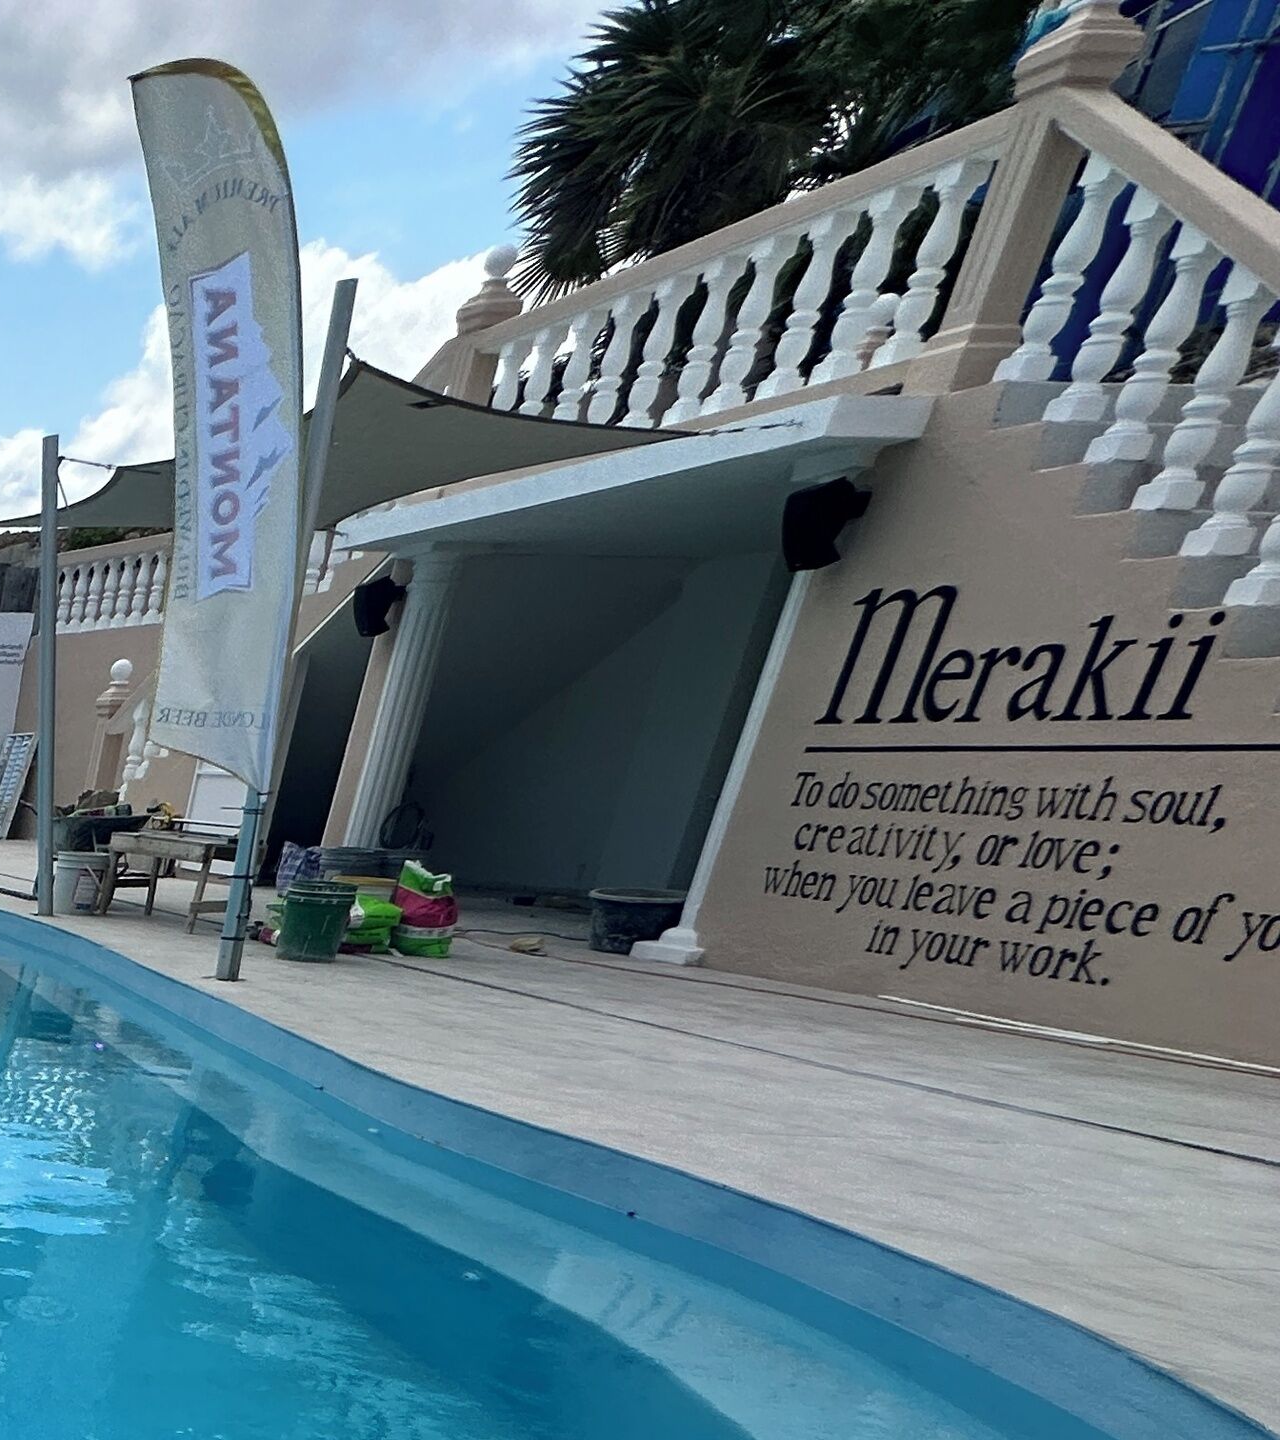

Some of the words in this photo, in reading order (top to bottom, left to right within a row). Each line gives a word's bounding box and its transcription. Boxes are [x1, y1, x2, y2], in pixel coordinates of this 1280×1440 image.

[814, 584, 1226, 726] Merakii
[791, 771, 825, 807] To
[828, 771, 860, 809] do
[860, 776, 1030, 821] something
[1036, 776, 1119, 821] with
[1122, 784, 1227, 833] soul,
[794, 822, 966, 873] creativity,
[976, 833, 1018, 867] or
[1018, 830, 1121, 880] love;
[763, 859, 837, 901] when
[835, 874, 900, 914] you
[901, 874, 997, 919] leave
[1004, 890, 1032, 925] a
[1034, 888, 1160, 937] piece
[1172, 892, 1236, 944] of
[864, 919, 900, 956] in
[899, 928, 991, 970] your
[999, 938, 1110, 987] work.
